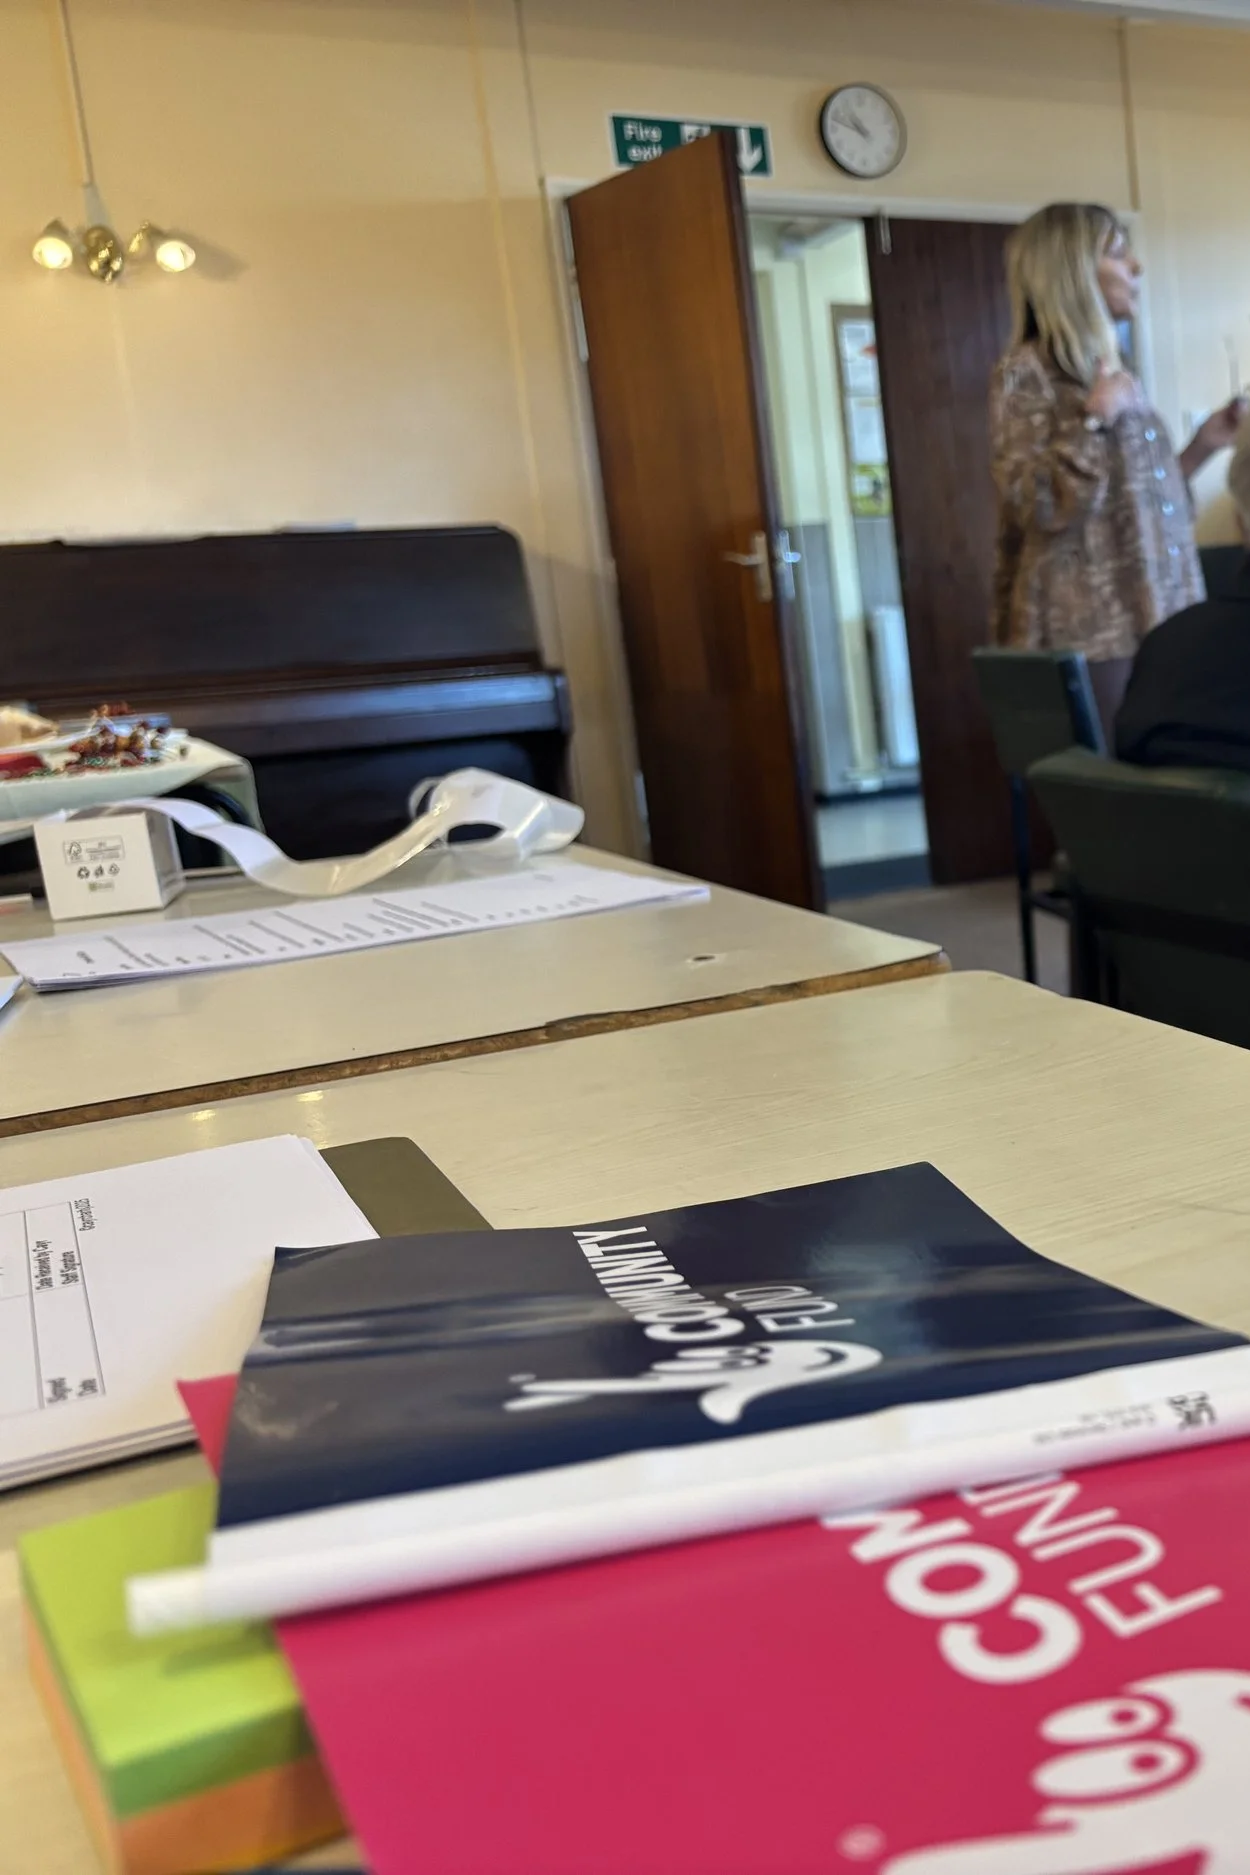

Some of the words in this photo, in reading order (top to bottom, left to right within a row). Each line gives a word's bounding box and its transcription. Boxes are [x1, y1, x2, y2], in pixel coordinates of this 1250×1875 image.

[623, 121, 662, 142] Fire
[34, 1257, 51, 1278] Received
[60, 1251, 80, 1272] Signature
[35, 1277, 53, 1290] Date
[573, 1225, 746, 1342] COMMUNITY
[725, 1284, 856, 1333] FUND
